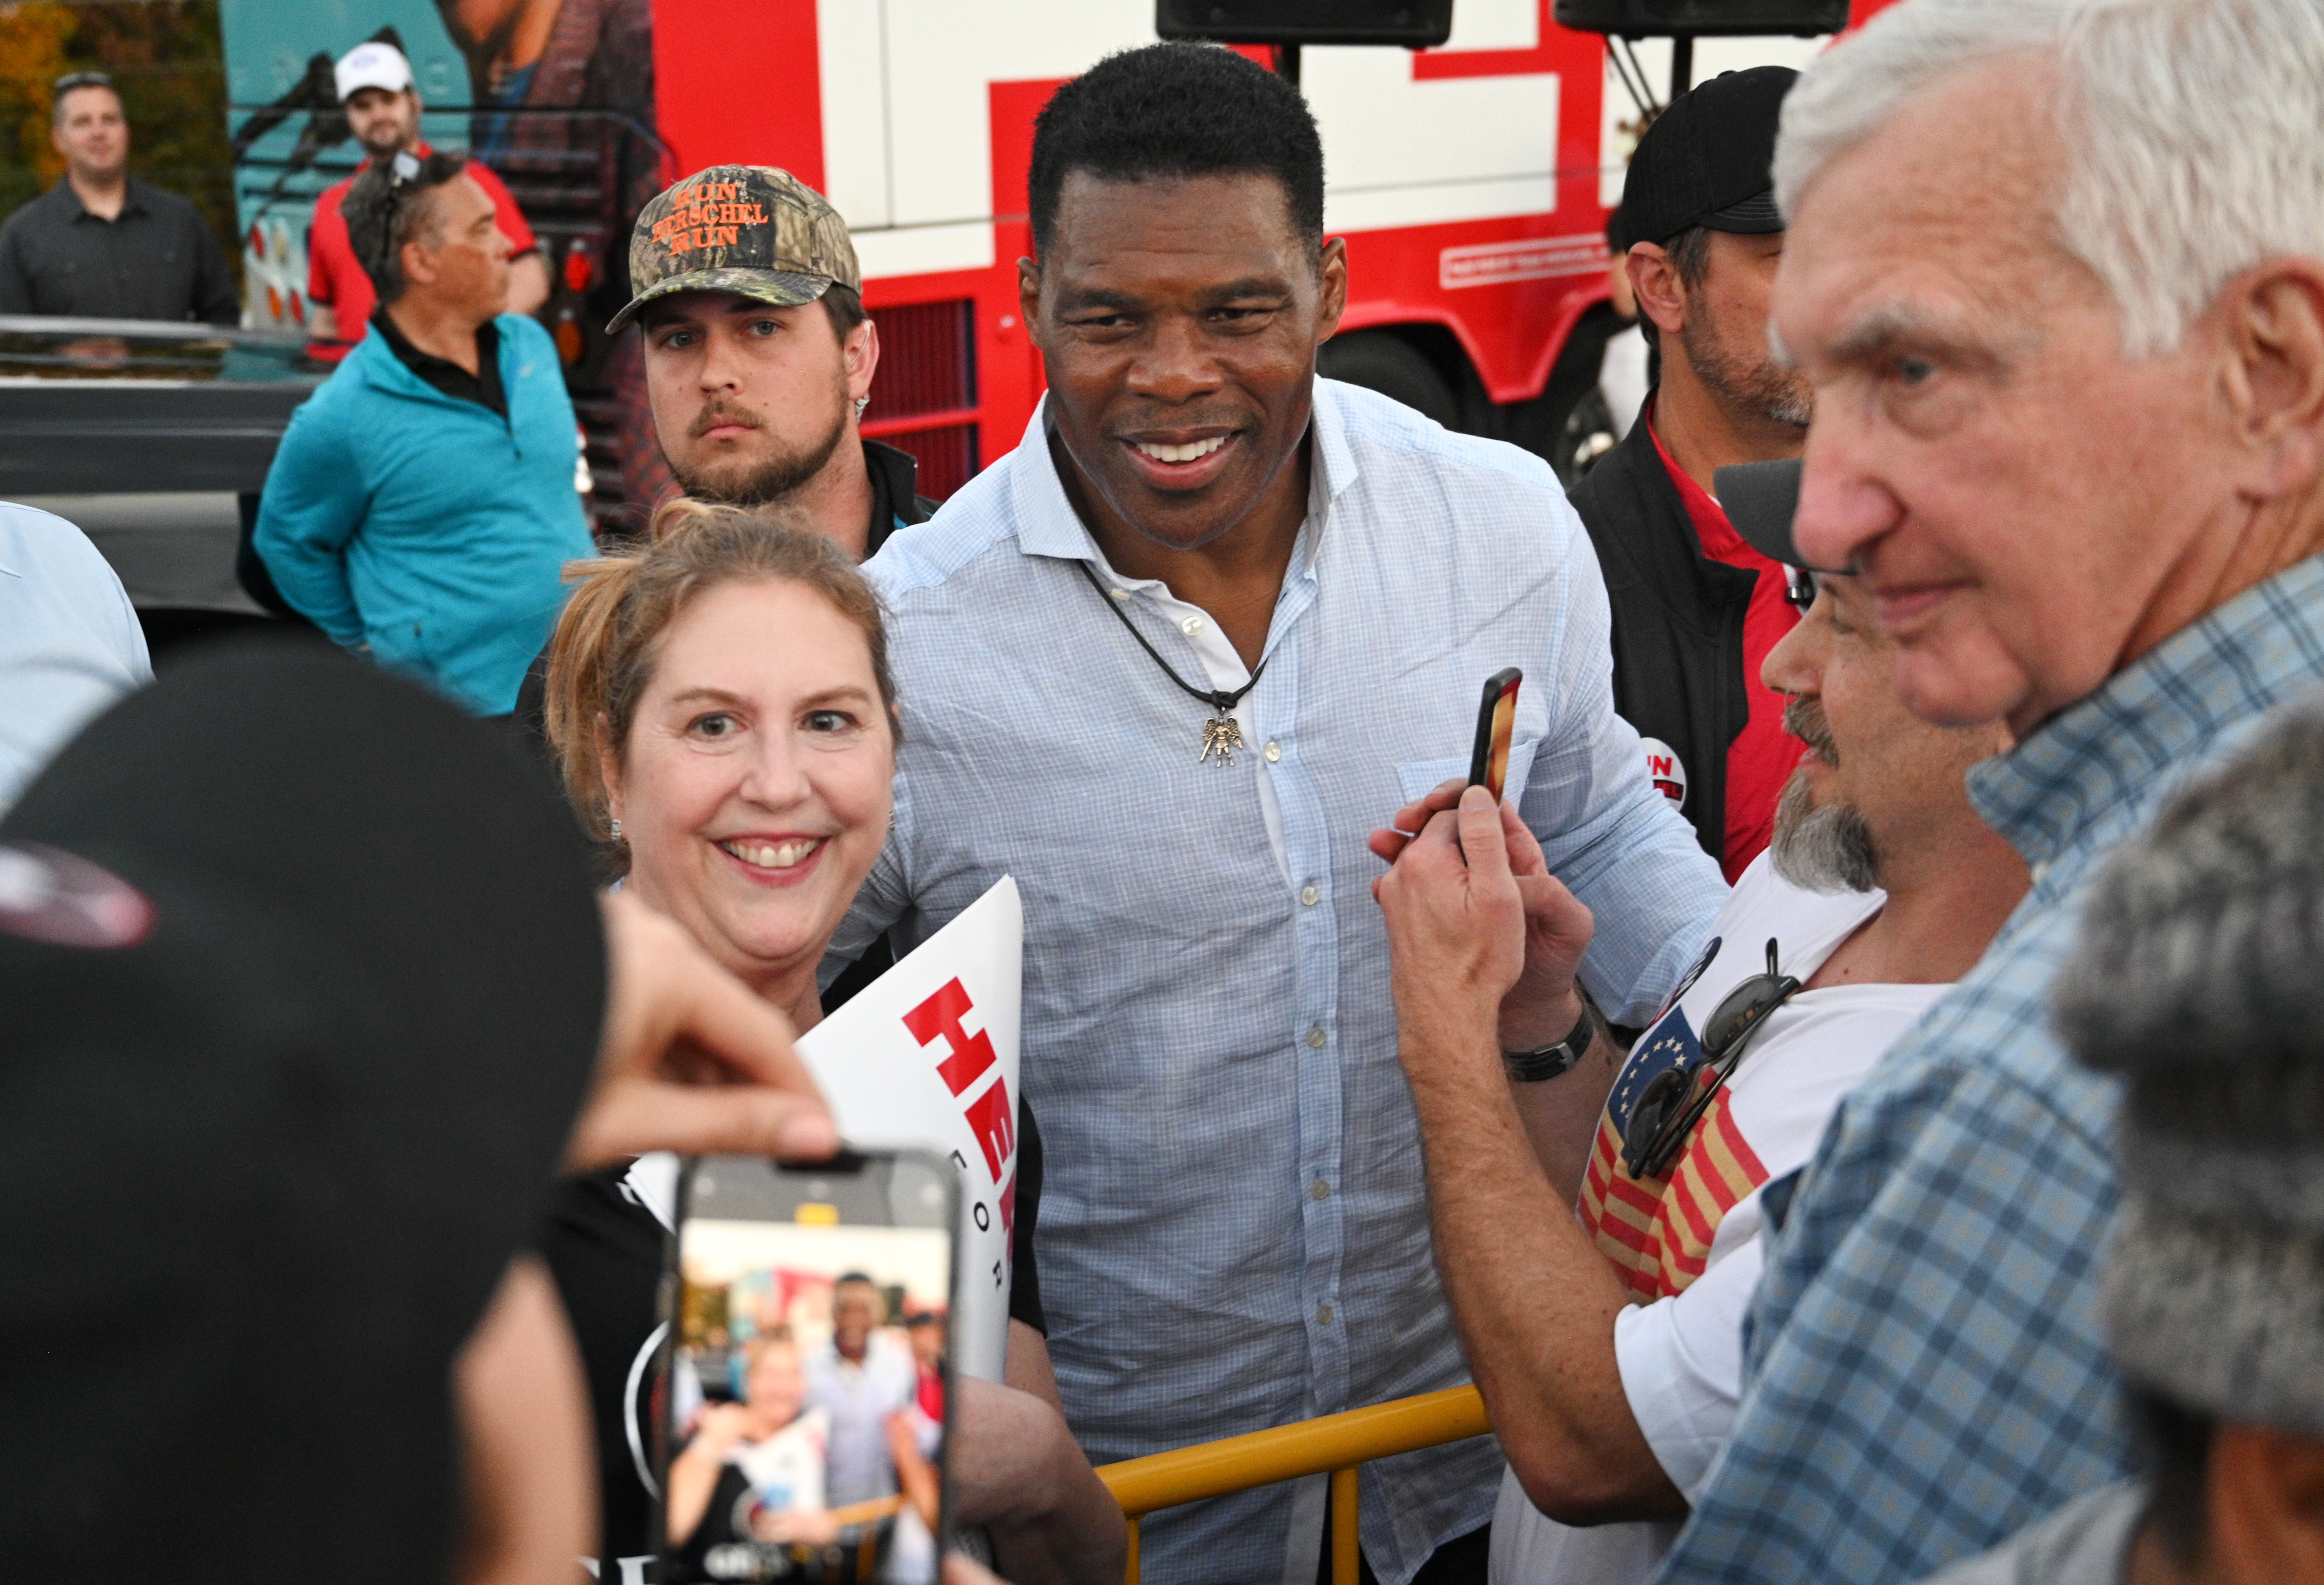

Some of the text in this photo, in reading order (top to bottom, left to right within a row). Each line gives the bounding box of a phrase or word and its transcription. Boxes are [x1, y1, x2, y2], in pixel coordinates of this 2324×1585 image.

[671, 183, 738, 211] RUN
[651, 203, 769, 243] HERSCHEL
[669, 226, 740, 256] RUN
